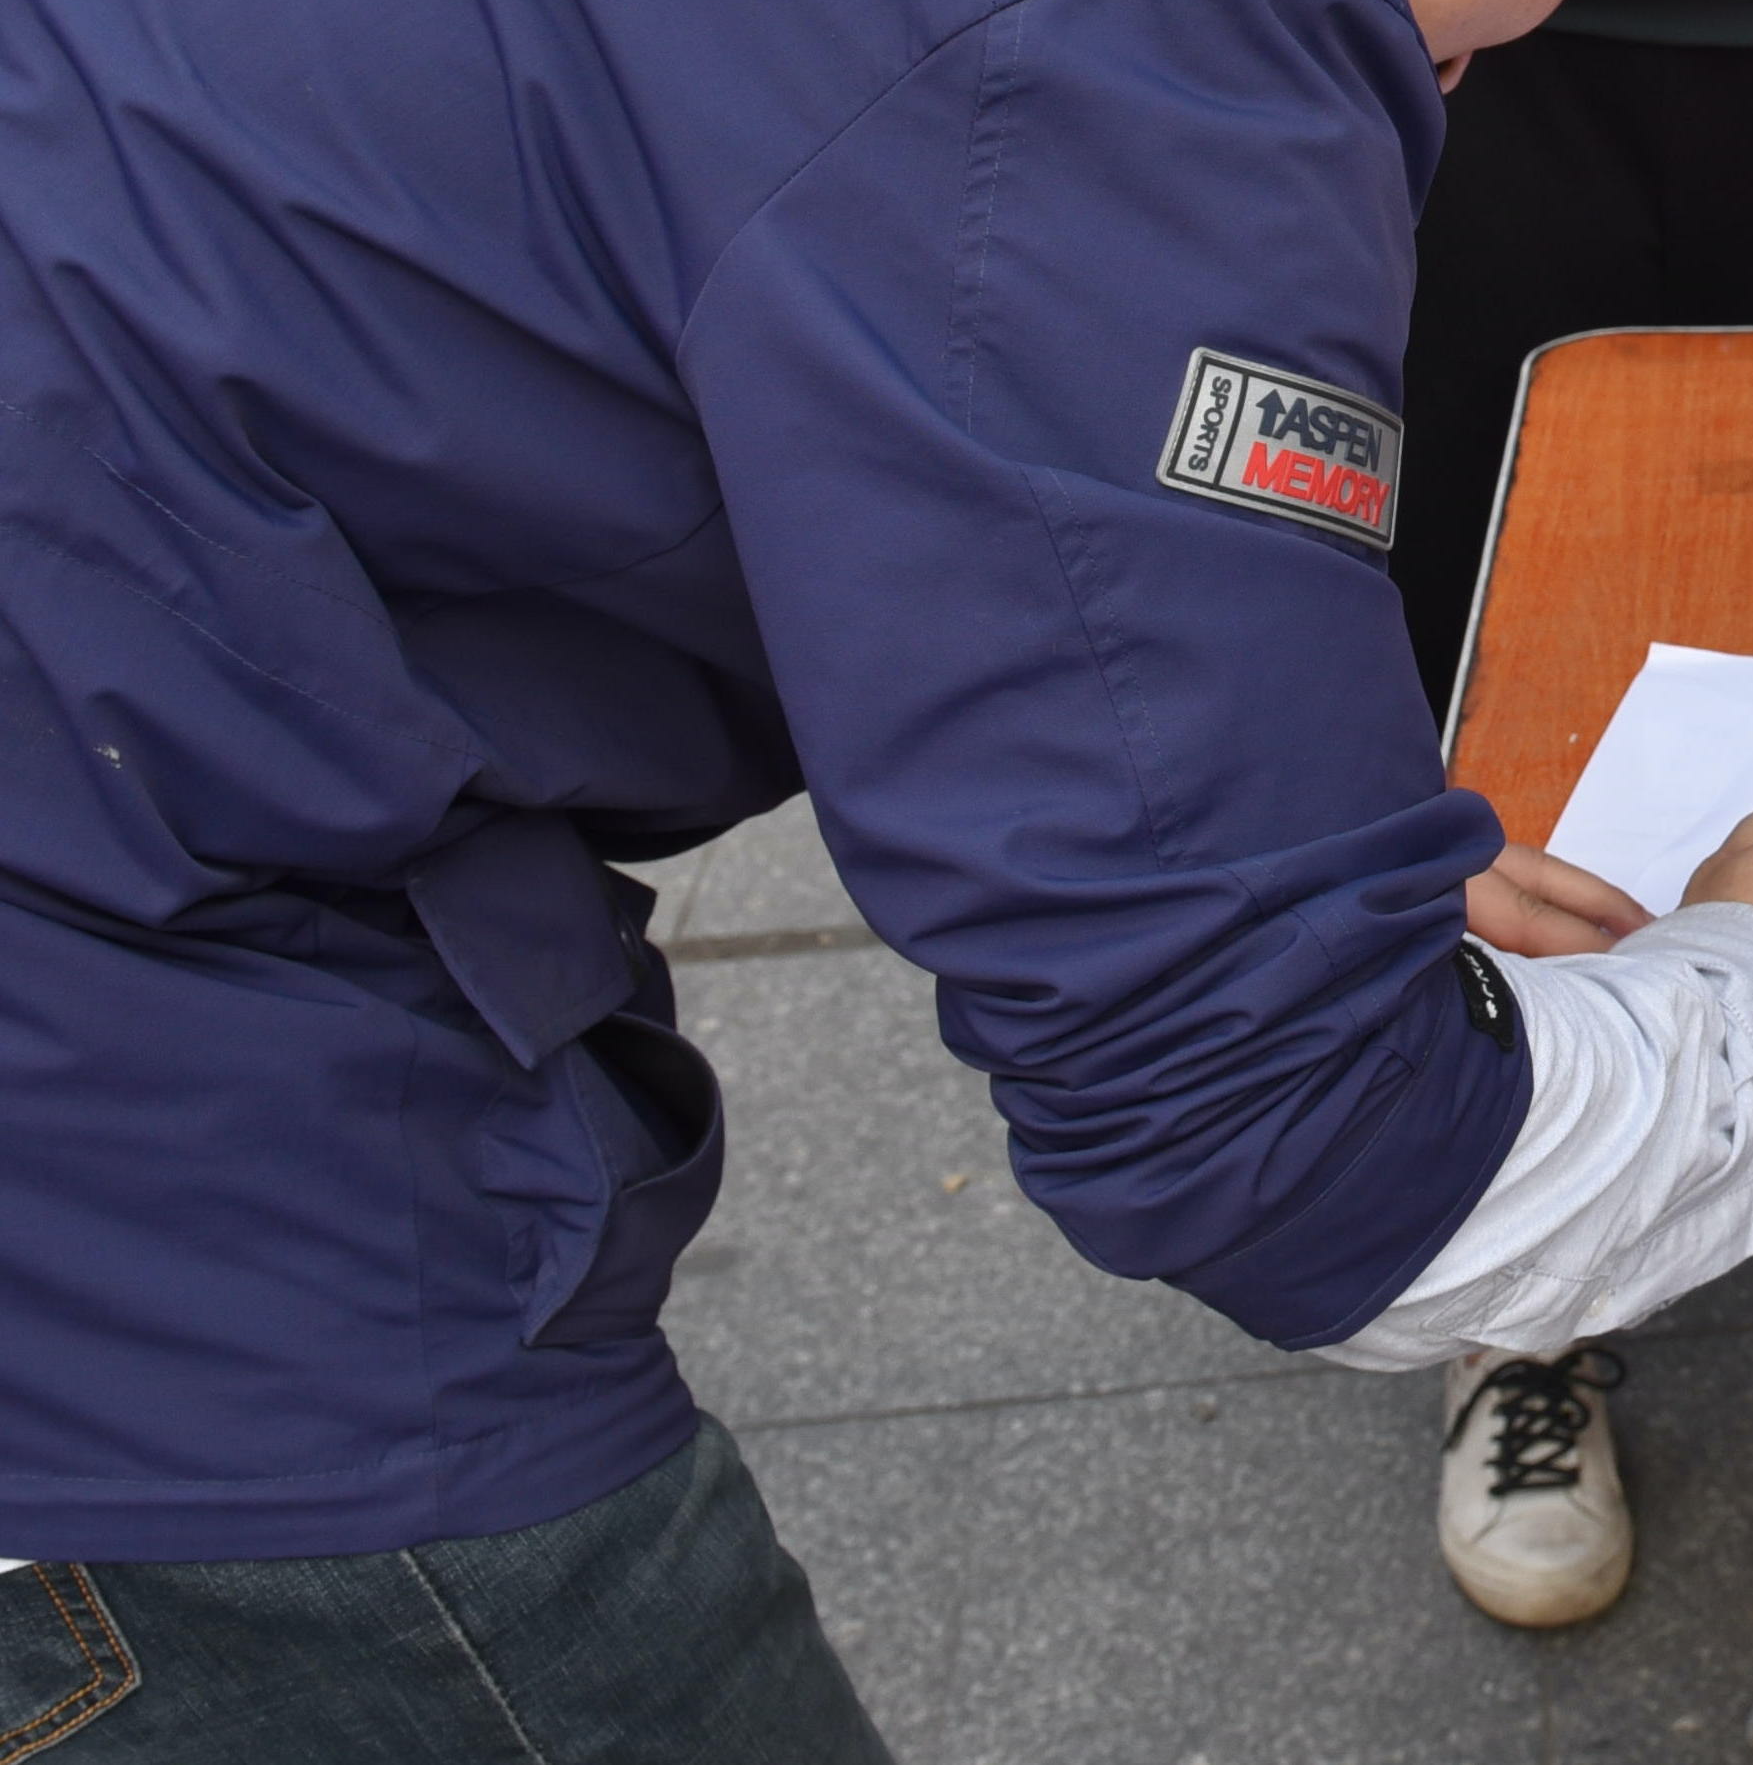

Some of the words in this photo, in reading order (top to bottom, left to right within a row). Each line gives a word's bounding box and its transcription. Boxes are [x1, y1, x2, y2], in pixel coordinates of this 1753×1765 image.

[1188, 375, 1232, 472] SPORTS
[1273, 397, 1382, 472] ASPEN
[1242, 441, 1391, 527] MEMORY
